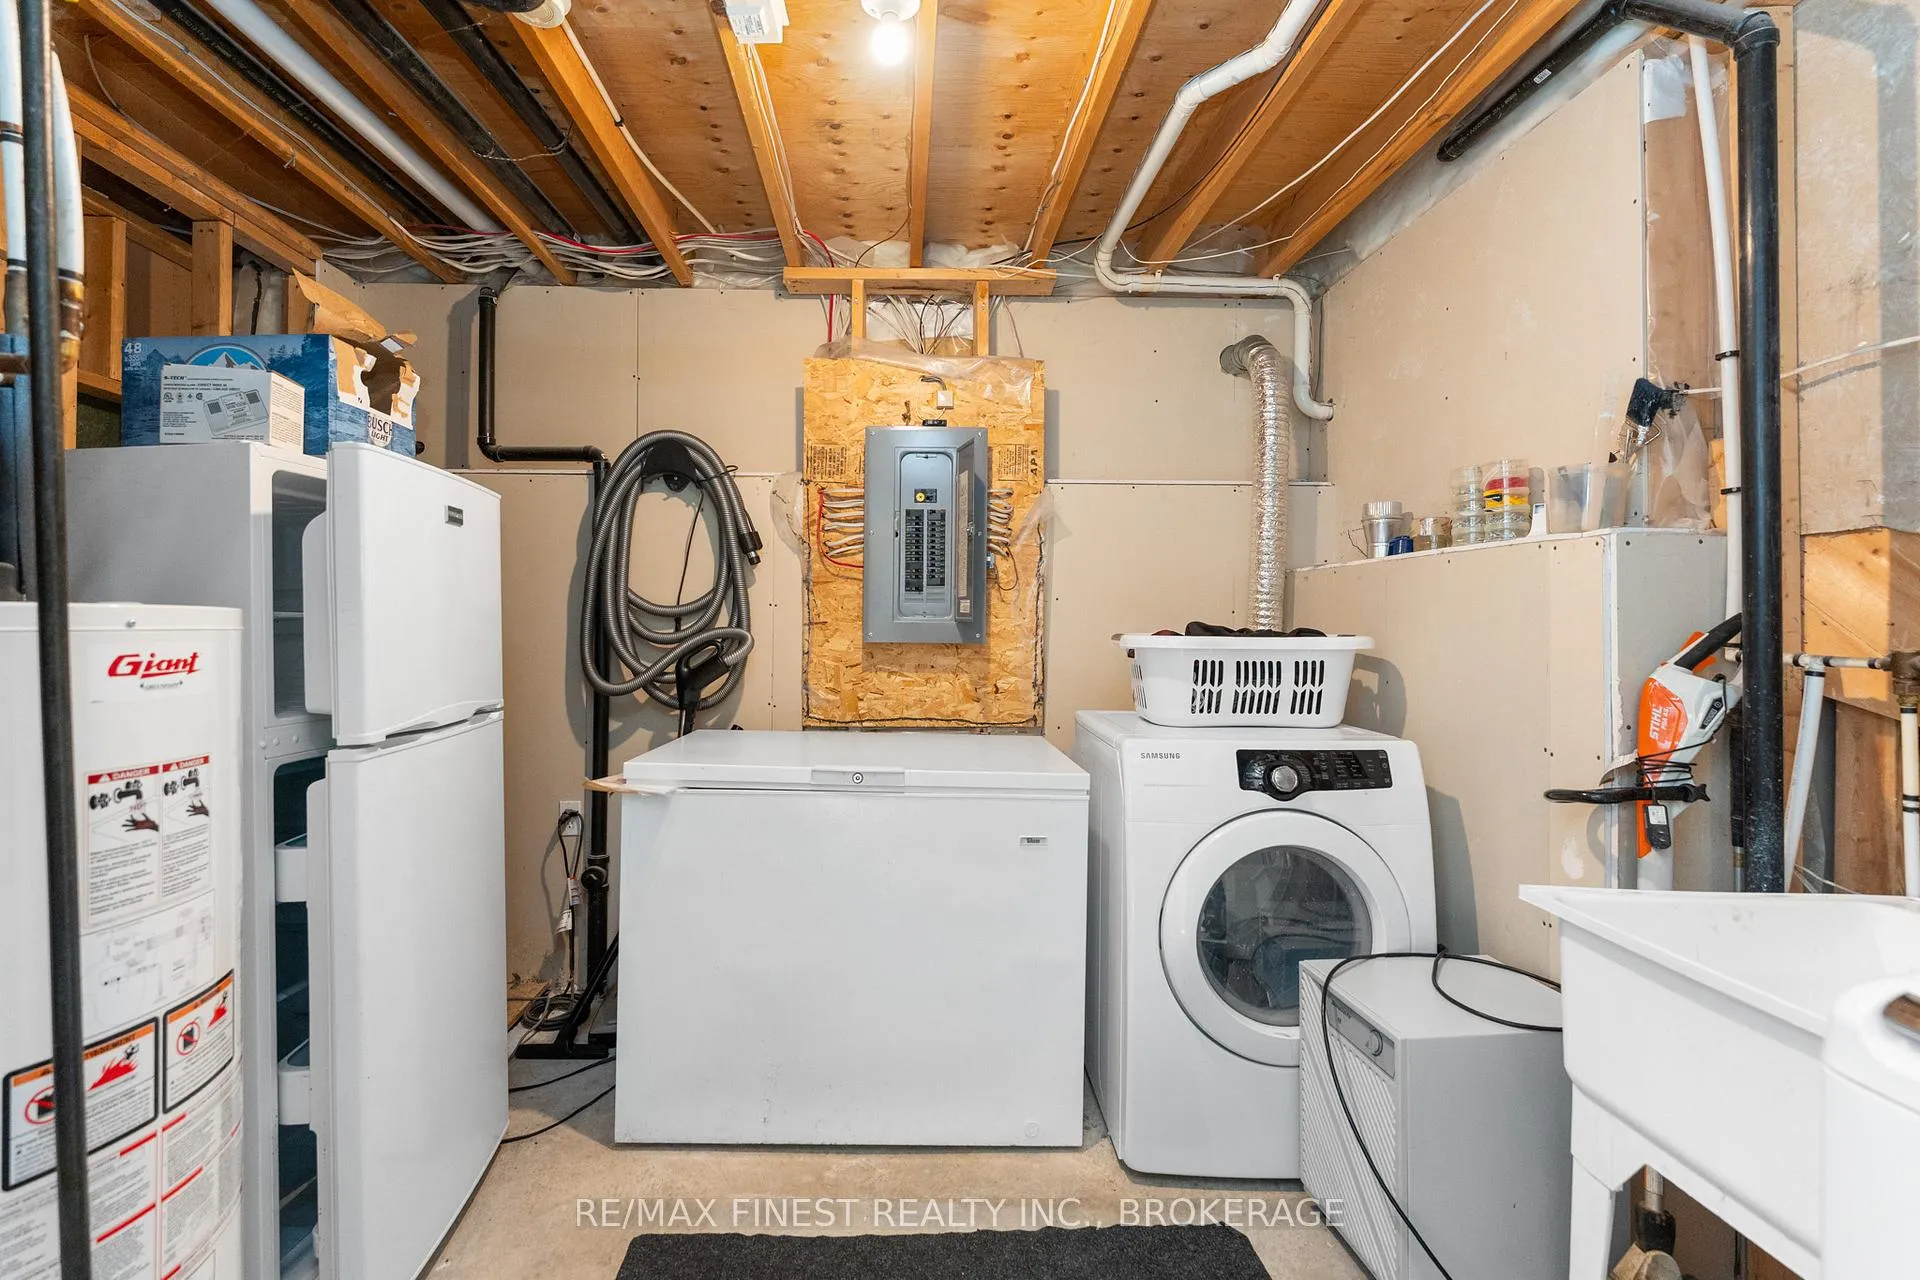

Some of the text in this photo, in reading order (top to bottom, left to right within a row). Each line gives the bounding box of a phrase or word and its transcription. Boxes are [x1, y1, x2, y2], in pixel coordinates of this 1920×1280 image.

[125, 342, 142, 354] 48
[371, 430, 389, 442] LIGHT
[108, 652, 200, 678] Giant
[1650, 704, 1663, 741] STIHL
[1140, 752, 1181, 760] SAMSUNG
[112, 767, 150, 780] DANGER
